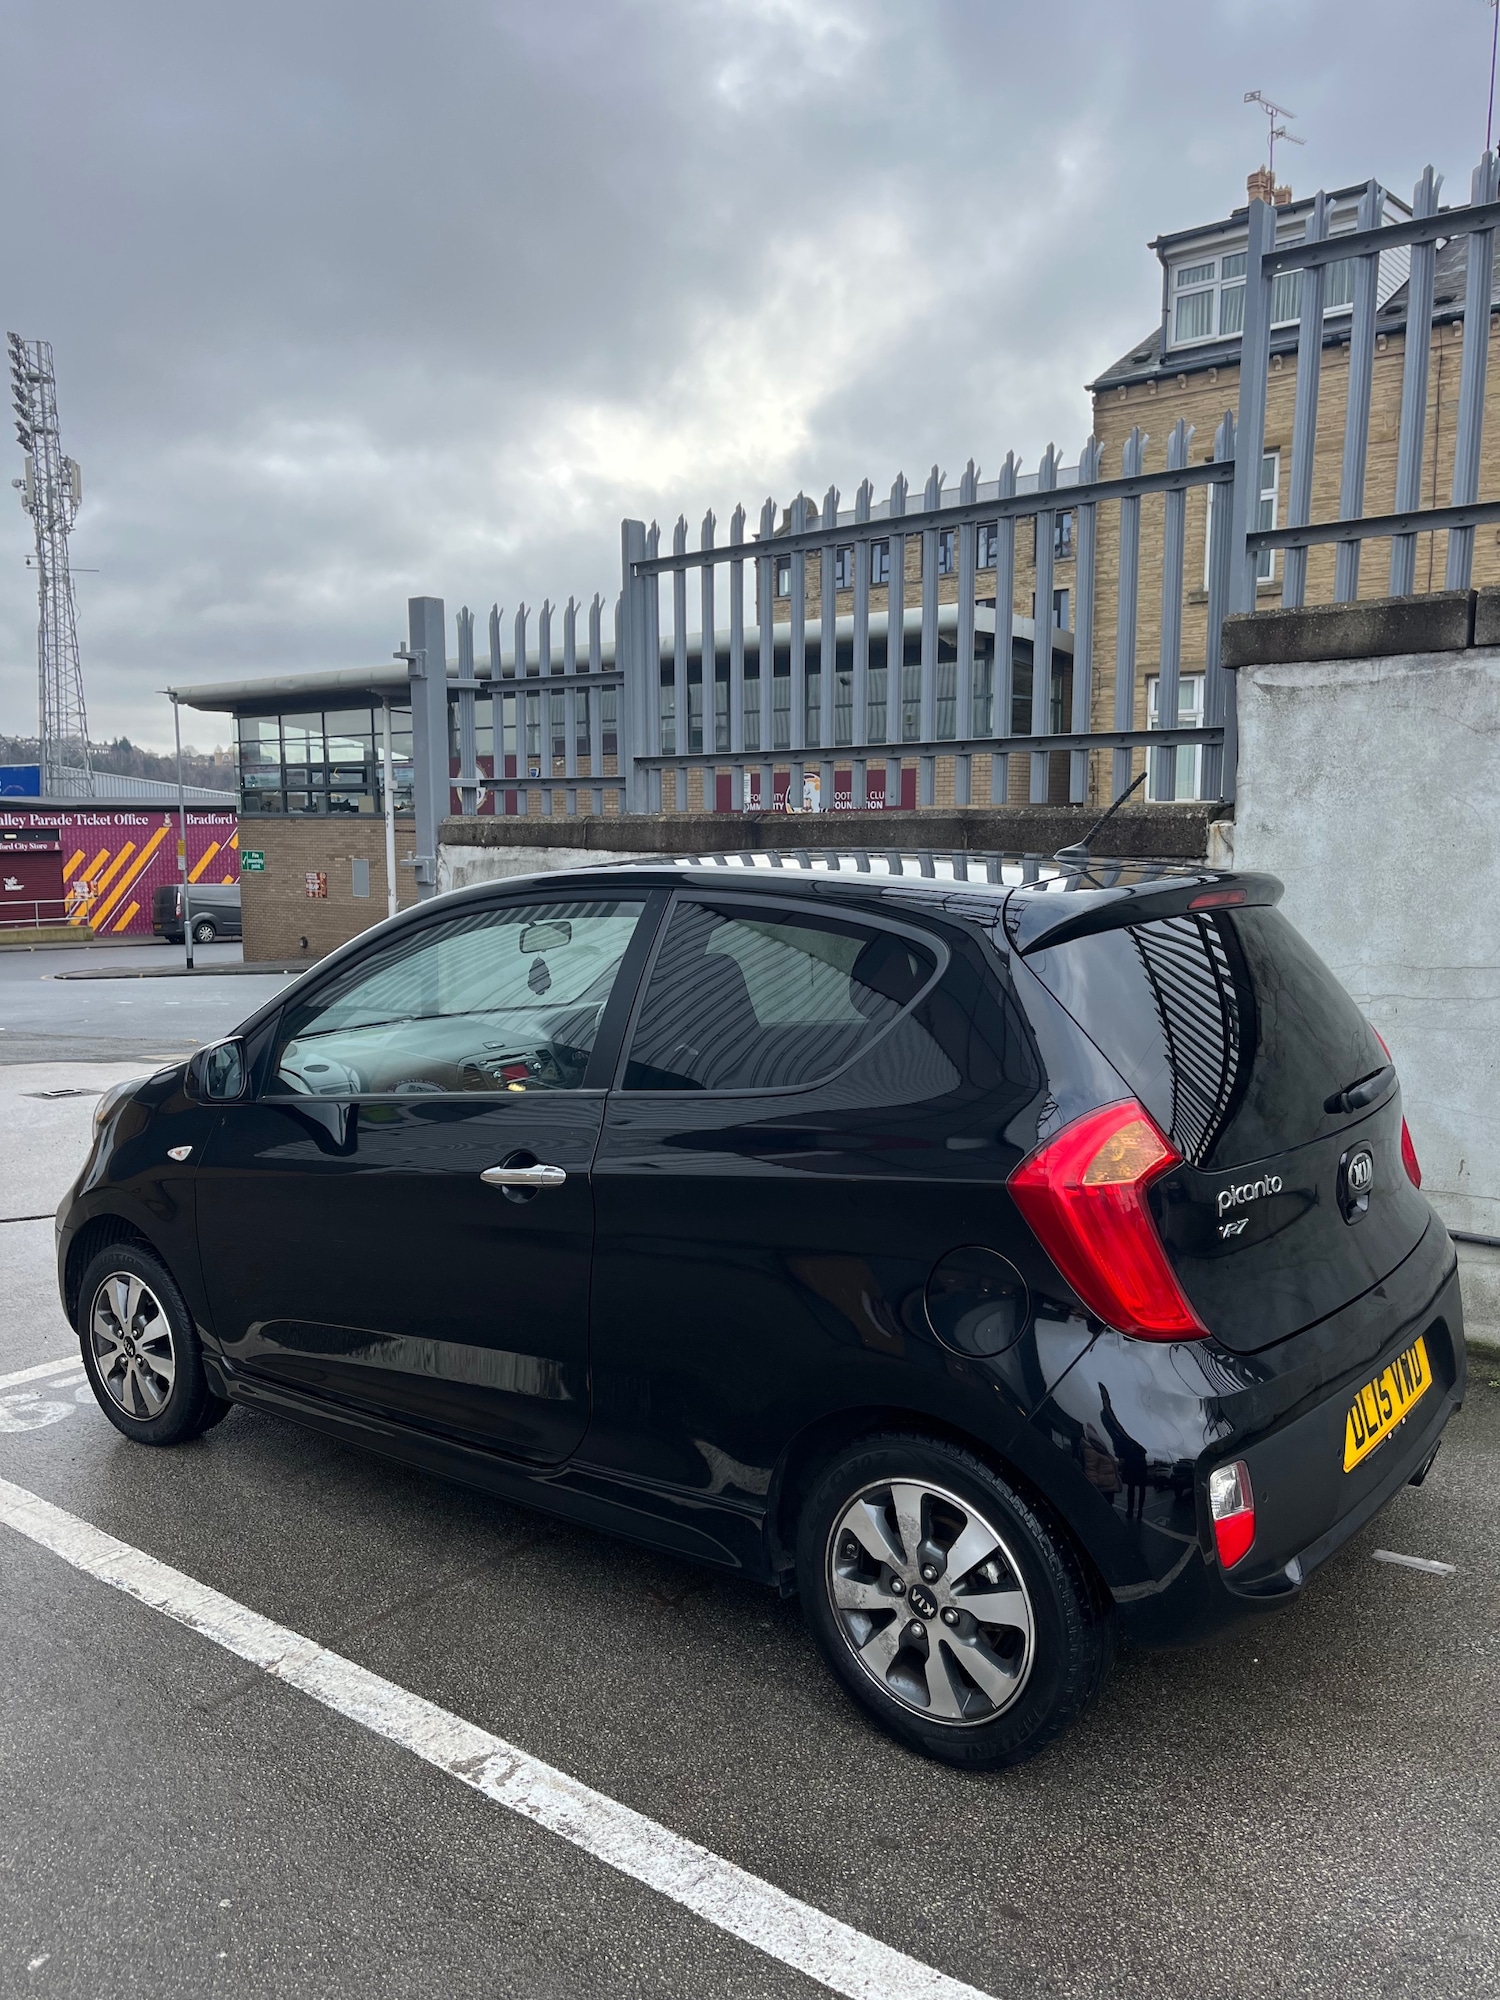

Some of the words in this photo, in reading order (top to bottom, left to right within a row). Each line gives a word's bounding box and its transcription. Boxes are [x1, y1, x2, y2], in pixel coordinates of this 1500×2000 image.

[870, 791, 885, 800] CLU
[29, 813, 73, 826] Parade
[73, 813, 111, 826] Ticket
[114, 813, 149, 826] Office
[186, 813, 233, 825] Bradford
[14, 841, 28, 851] City
[29, 841, 48, 850] Store
[1217, 1174, 1283, 1218] picanto
[911, 1587, 936, 1617] KIA
